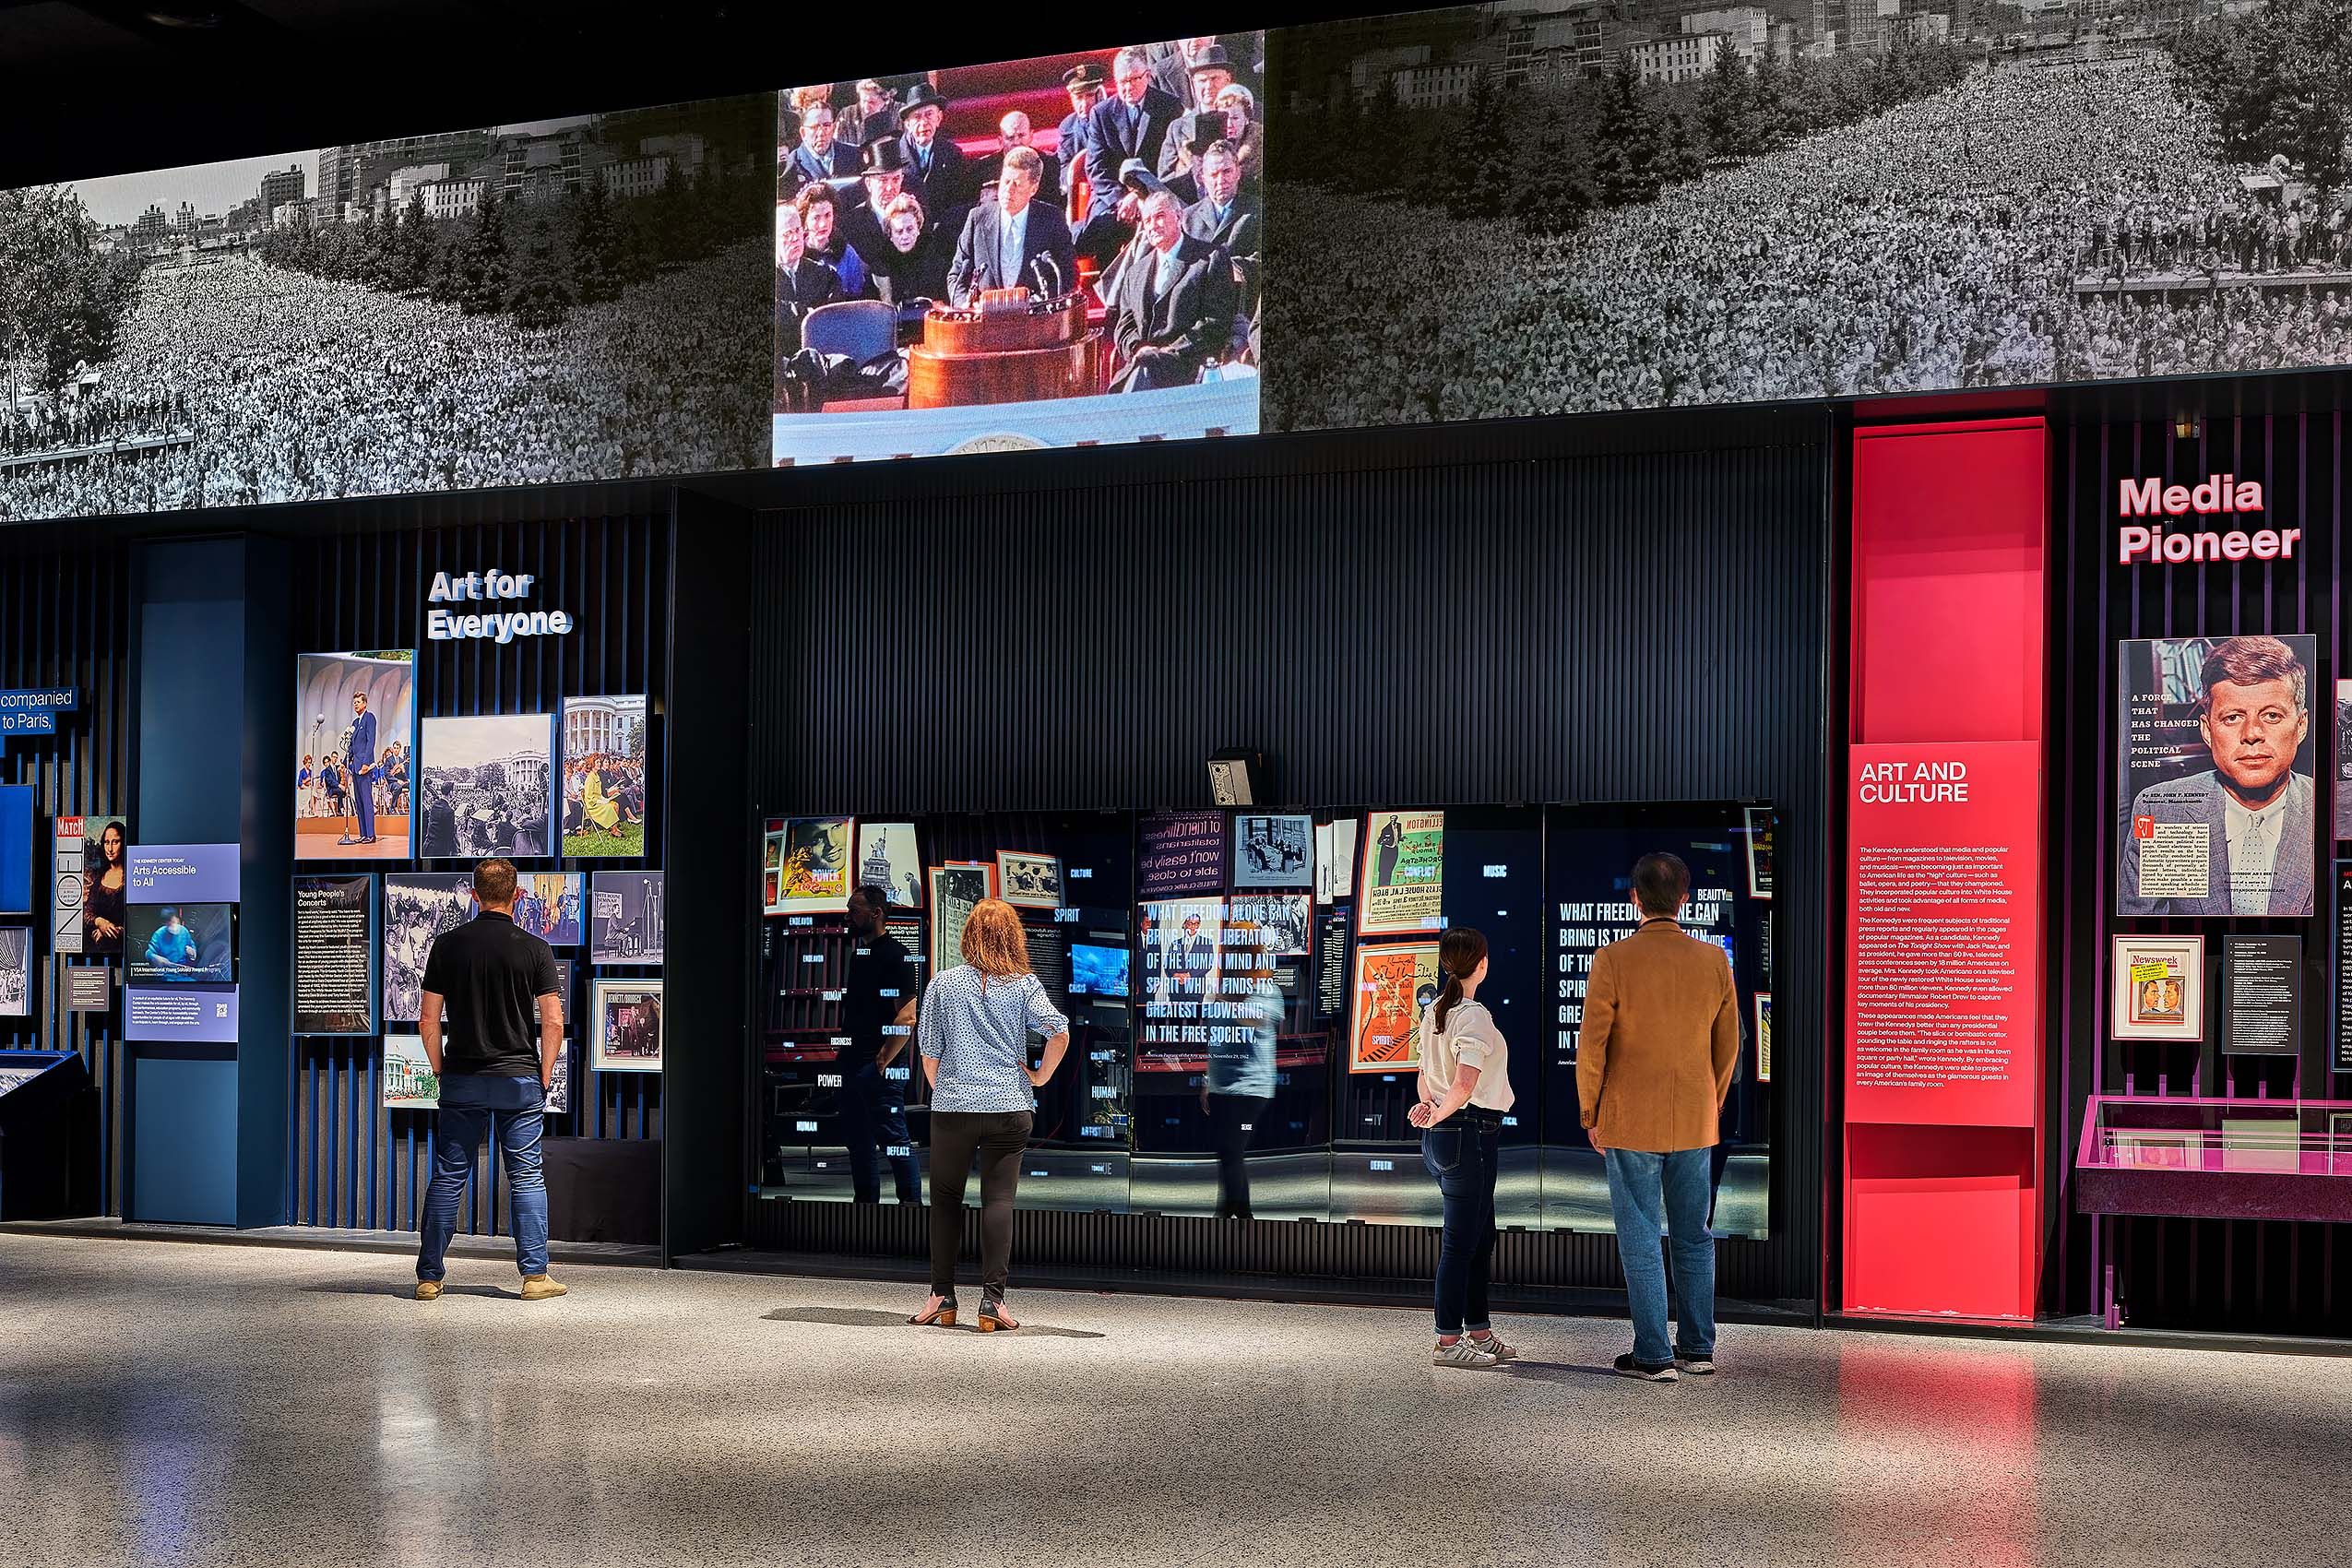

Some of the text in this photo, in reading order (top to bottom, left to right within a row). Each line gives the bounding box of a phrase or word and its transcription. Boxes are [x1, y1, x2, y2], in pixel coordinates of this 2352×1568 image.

[2120, 473, 2263, 517] Media
[2120, 525, 2300, 564] Pioneer
[427, 568, 535, 602] Art for
[427, 609, 574, 644] Everyone
[1, 689, 72, 709] companied
[2, 713, 52, 730] to Paris,
[1859, 762, 1966, 781] ART AND
[1859, 783, 1969, 803] CULTURE
[57, 819, 83, 835] MATCH
[133, 865, 196, 875] Arts Accessible
[1070, 869, 1092, 878] CULTURE
[1483, 864, 1507, 877] MUSIC
[133, 877, 154, 886] to All
[298, 890, 344, 899] Young People's
[1697, 888, 1727, 901] BEAUTY
[1054, 908, 1080, 922] SPIRIT
[1146, 904, 1290, 921] WHAT FREEDOM ALONE CAN
[1560, 903, 1594, 921] WHAT
[1597, 903, 1642, 921] FREEDO
[1695, 903, 1719, 921] CAN
[789, 917, 813, 926] ENDEAVOR
[1146, 929, 1279, 945] BRING IS THE LIBERATION
[1560, 929, 1595, 947] BRING
[1598, 929, 1610, 947] IS
[802, 954, 824, 963] ENDEAVOR
[1146, 953, 1276, 969] OF THE HUMAN MIND AND
[1559, 954, 1595, 972] OF TH
[2132, 956, 2177, 964] Newsweek
[1146, 977, 1274, 994] SPIRIT WHICH FINDS ITS
[1559, 980, 1589, 997] SPIR
[822, 991, 842, 1001] HUMAN
[1146, 1002, 1264, 1019] GREATEST FLOWERING
[882, 1026, 910, 1036] CENTURIES
[1146, 1025, 1256, 1043] IN THE FREE SOCIETY.
[1558, 1030, 1571, 1049] IN
[817, 1074, 842, 1087] POWER
[885, 1067, 909, 1081] POWER
[1091, 1086, 1117, 1099] HUMAN
[796, 1121, 818, 1132] HUMAN
[886, 1146, 909, 1157] DEFEATS
